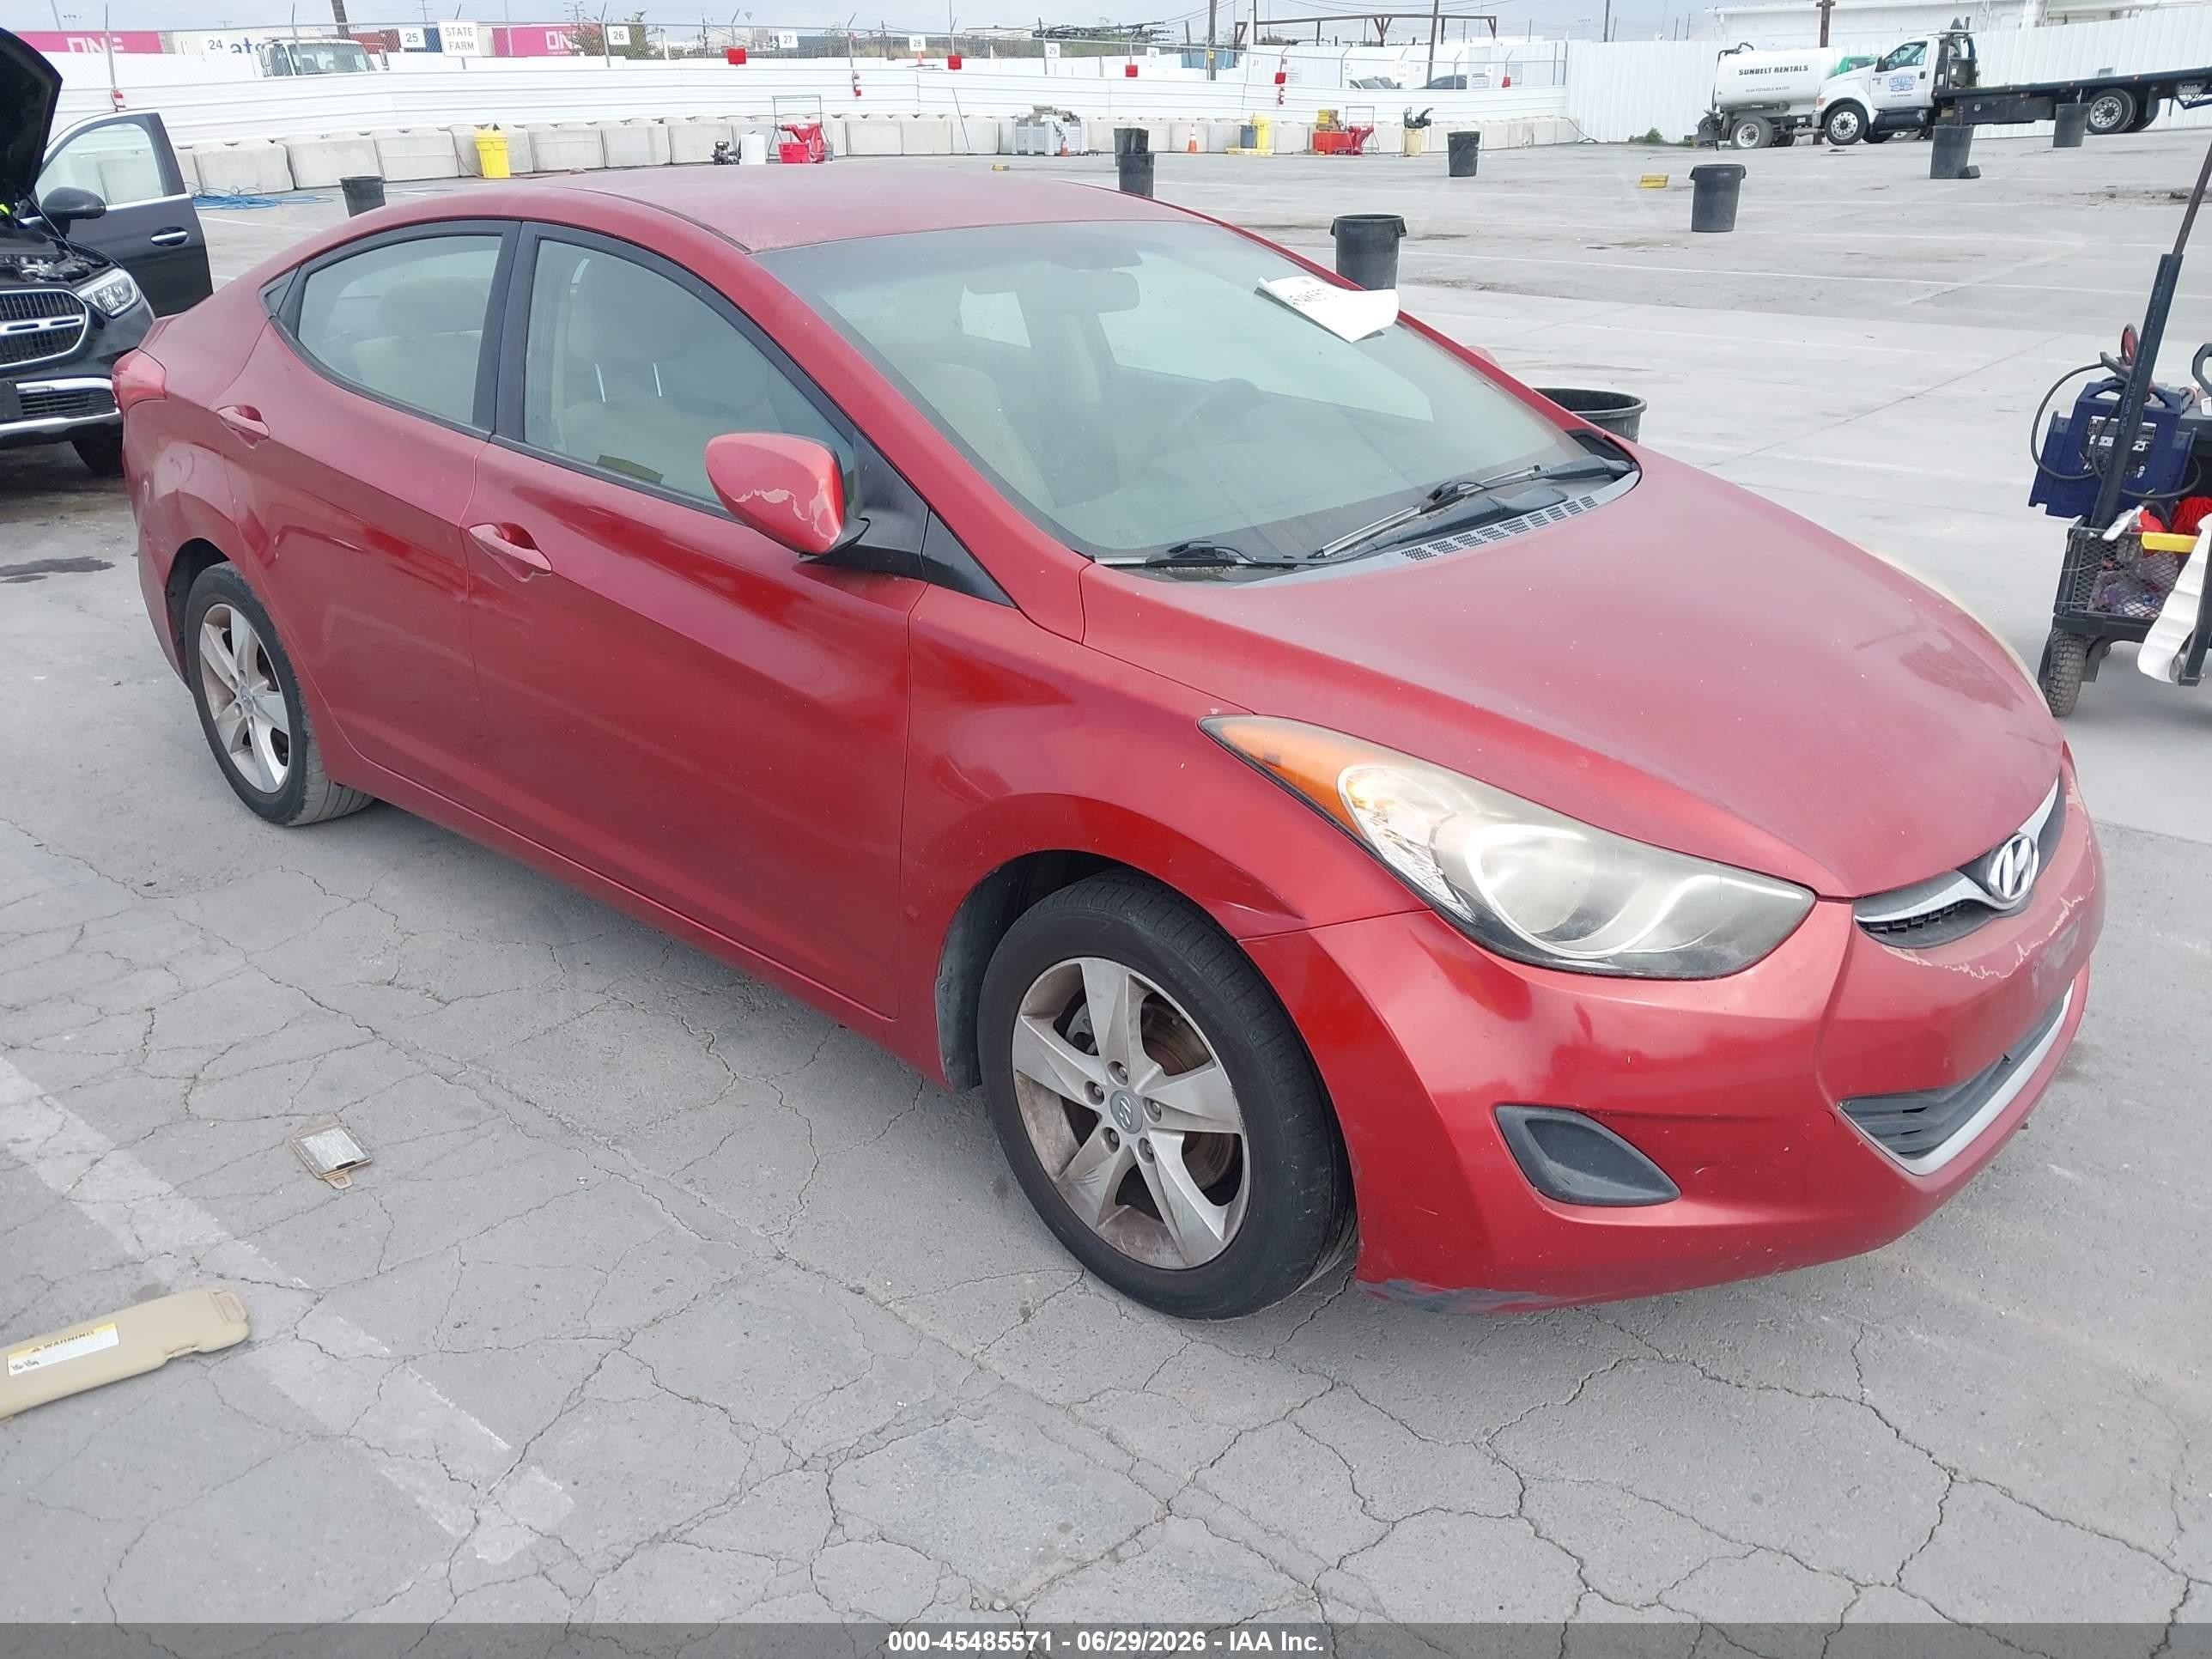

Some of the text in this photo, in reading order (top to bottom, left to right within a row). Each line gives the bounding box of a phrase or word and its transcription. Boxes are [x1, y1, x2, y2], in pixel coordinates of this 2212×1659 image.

[445, 27, 473, 37] STATE
[613, 31, 625, 40] 26
[405, 33, 419, 43] 25
[783, 34, 793, 44] 27
[208, 40, 223, 50] 24
[449, 41, 474, 51] FARM
[913, 39, 922, 48] 28
